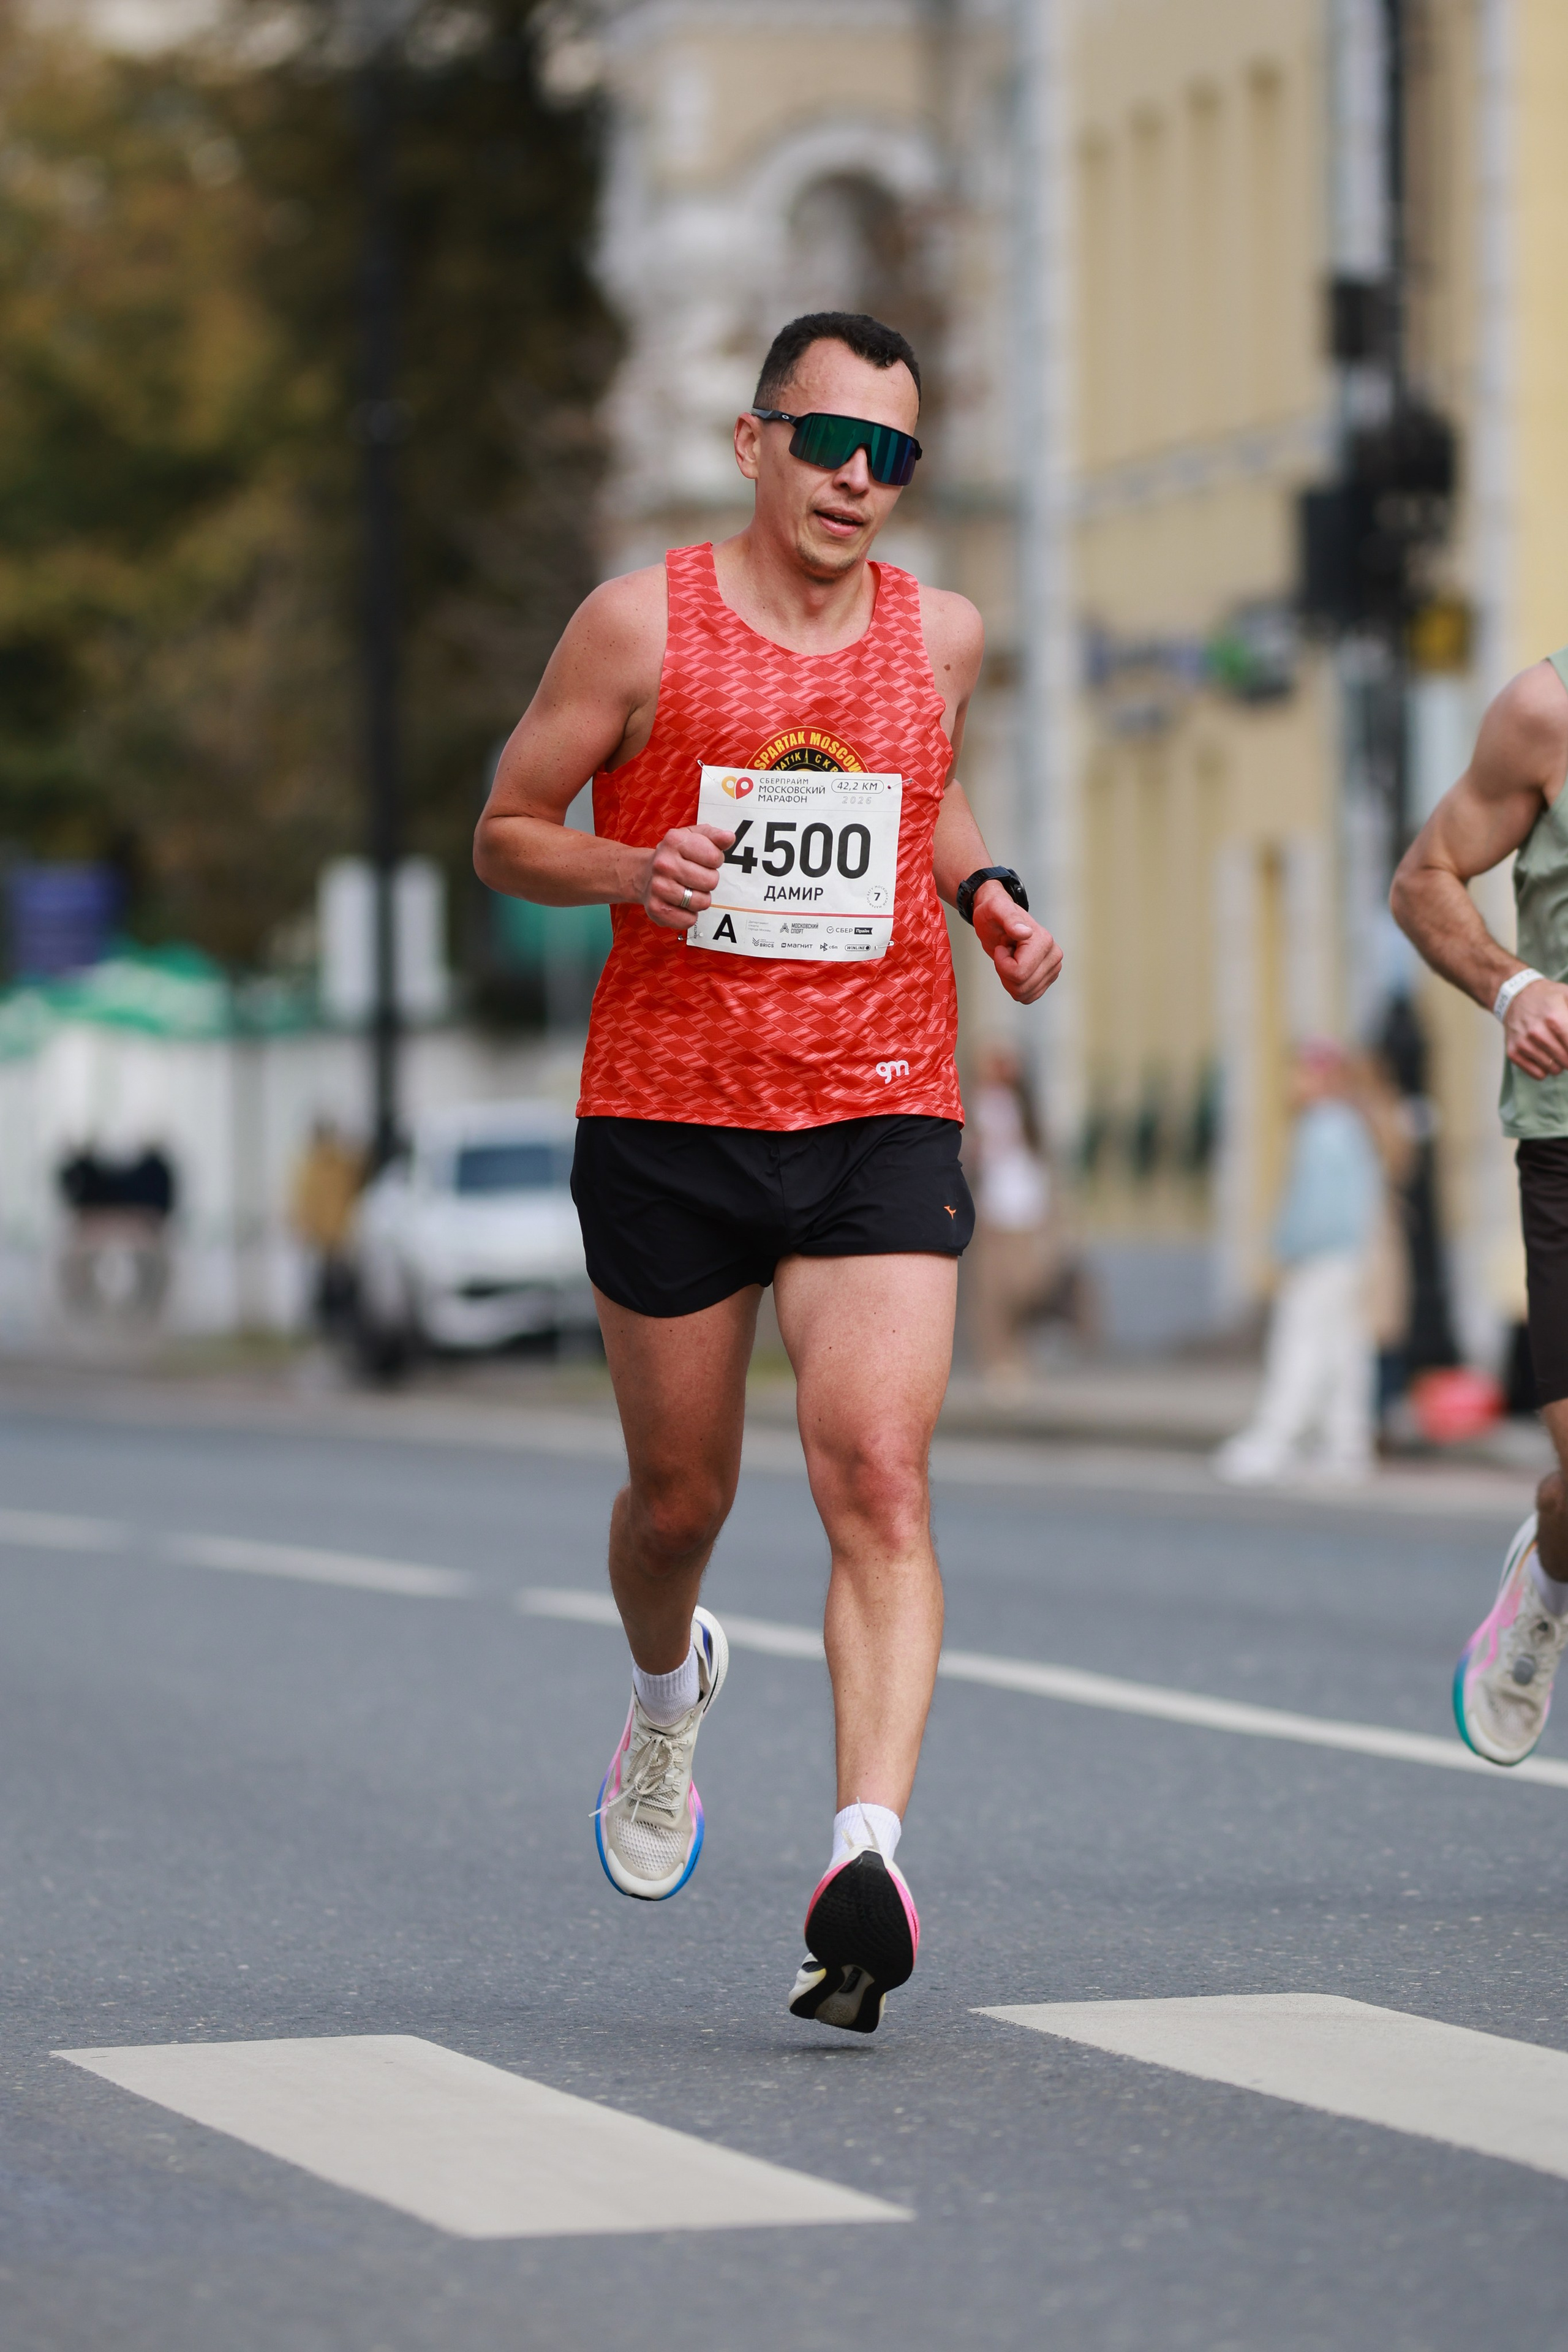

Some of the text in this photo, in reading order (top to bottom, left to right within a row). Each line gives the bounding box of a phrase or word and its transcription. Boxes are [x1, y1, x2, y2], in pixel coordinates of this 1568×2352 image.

[754, 731, 864, 773] SPARTAK MOSCOW
[758, 785, 826, 794] МОСКОВСКИЙ
[837, 782, 858, 791] 42,2
[758, 794, 807, 803] МАРАФОН
[842, 796, 872, 804] 2026
[724, 820, 871, 879] 4500
[764, 885, 824, 902] ДАМИР
[874, 892, 881, 901] 7
[712, 913, 737, 943] А
